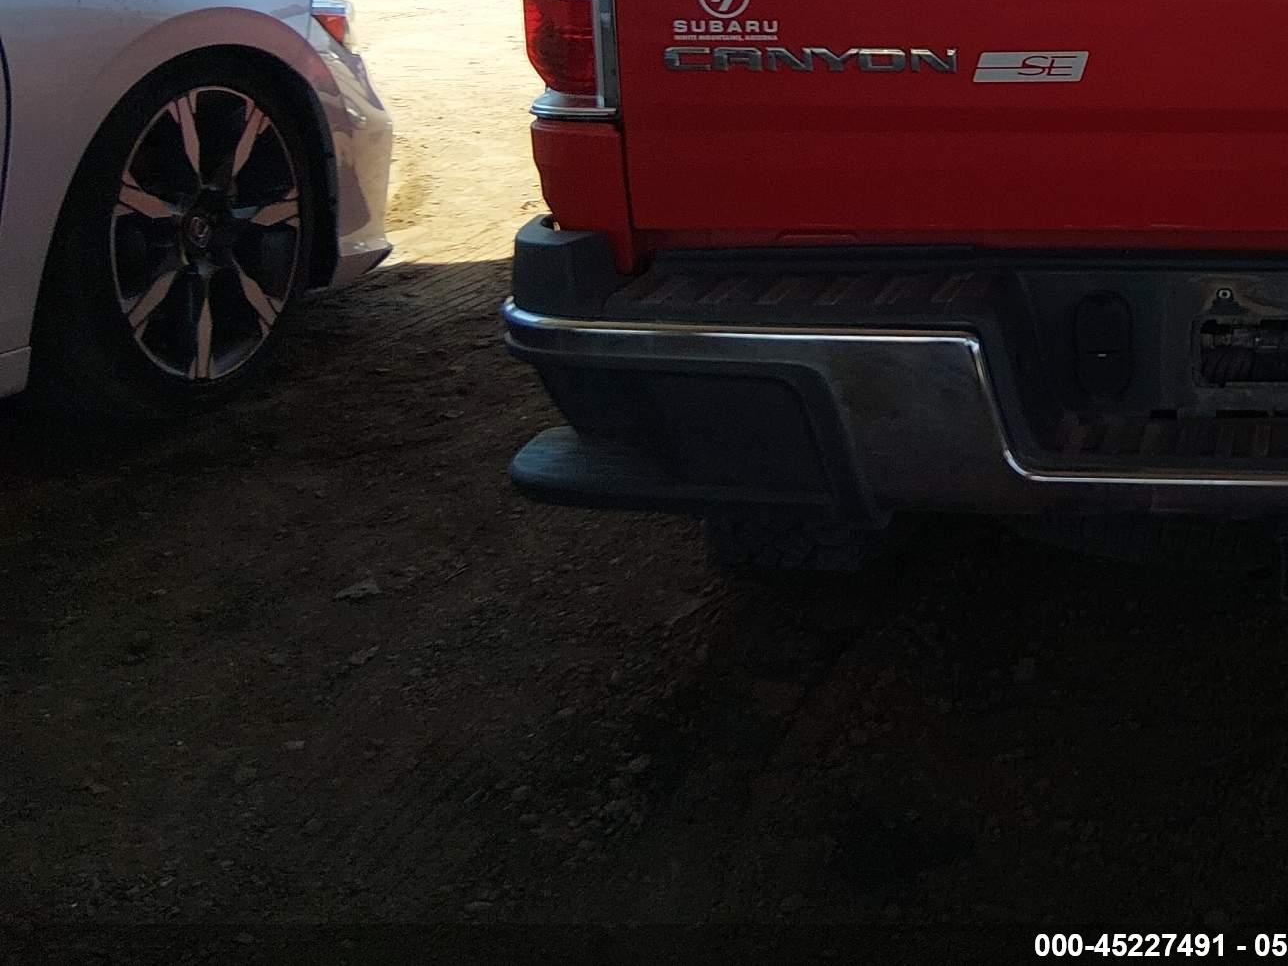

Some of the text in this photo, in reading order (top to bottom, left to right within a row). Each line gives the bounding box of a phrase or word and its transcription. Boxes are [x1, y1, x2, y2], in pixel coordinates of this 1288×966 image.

[673, 20, 778, 33] SUBARU
[663, 46, 958, 73] CANYON
[1017, 54, 1078, 77] SE
